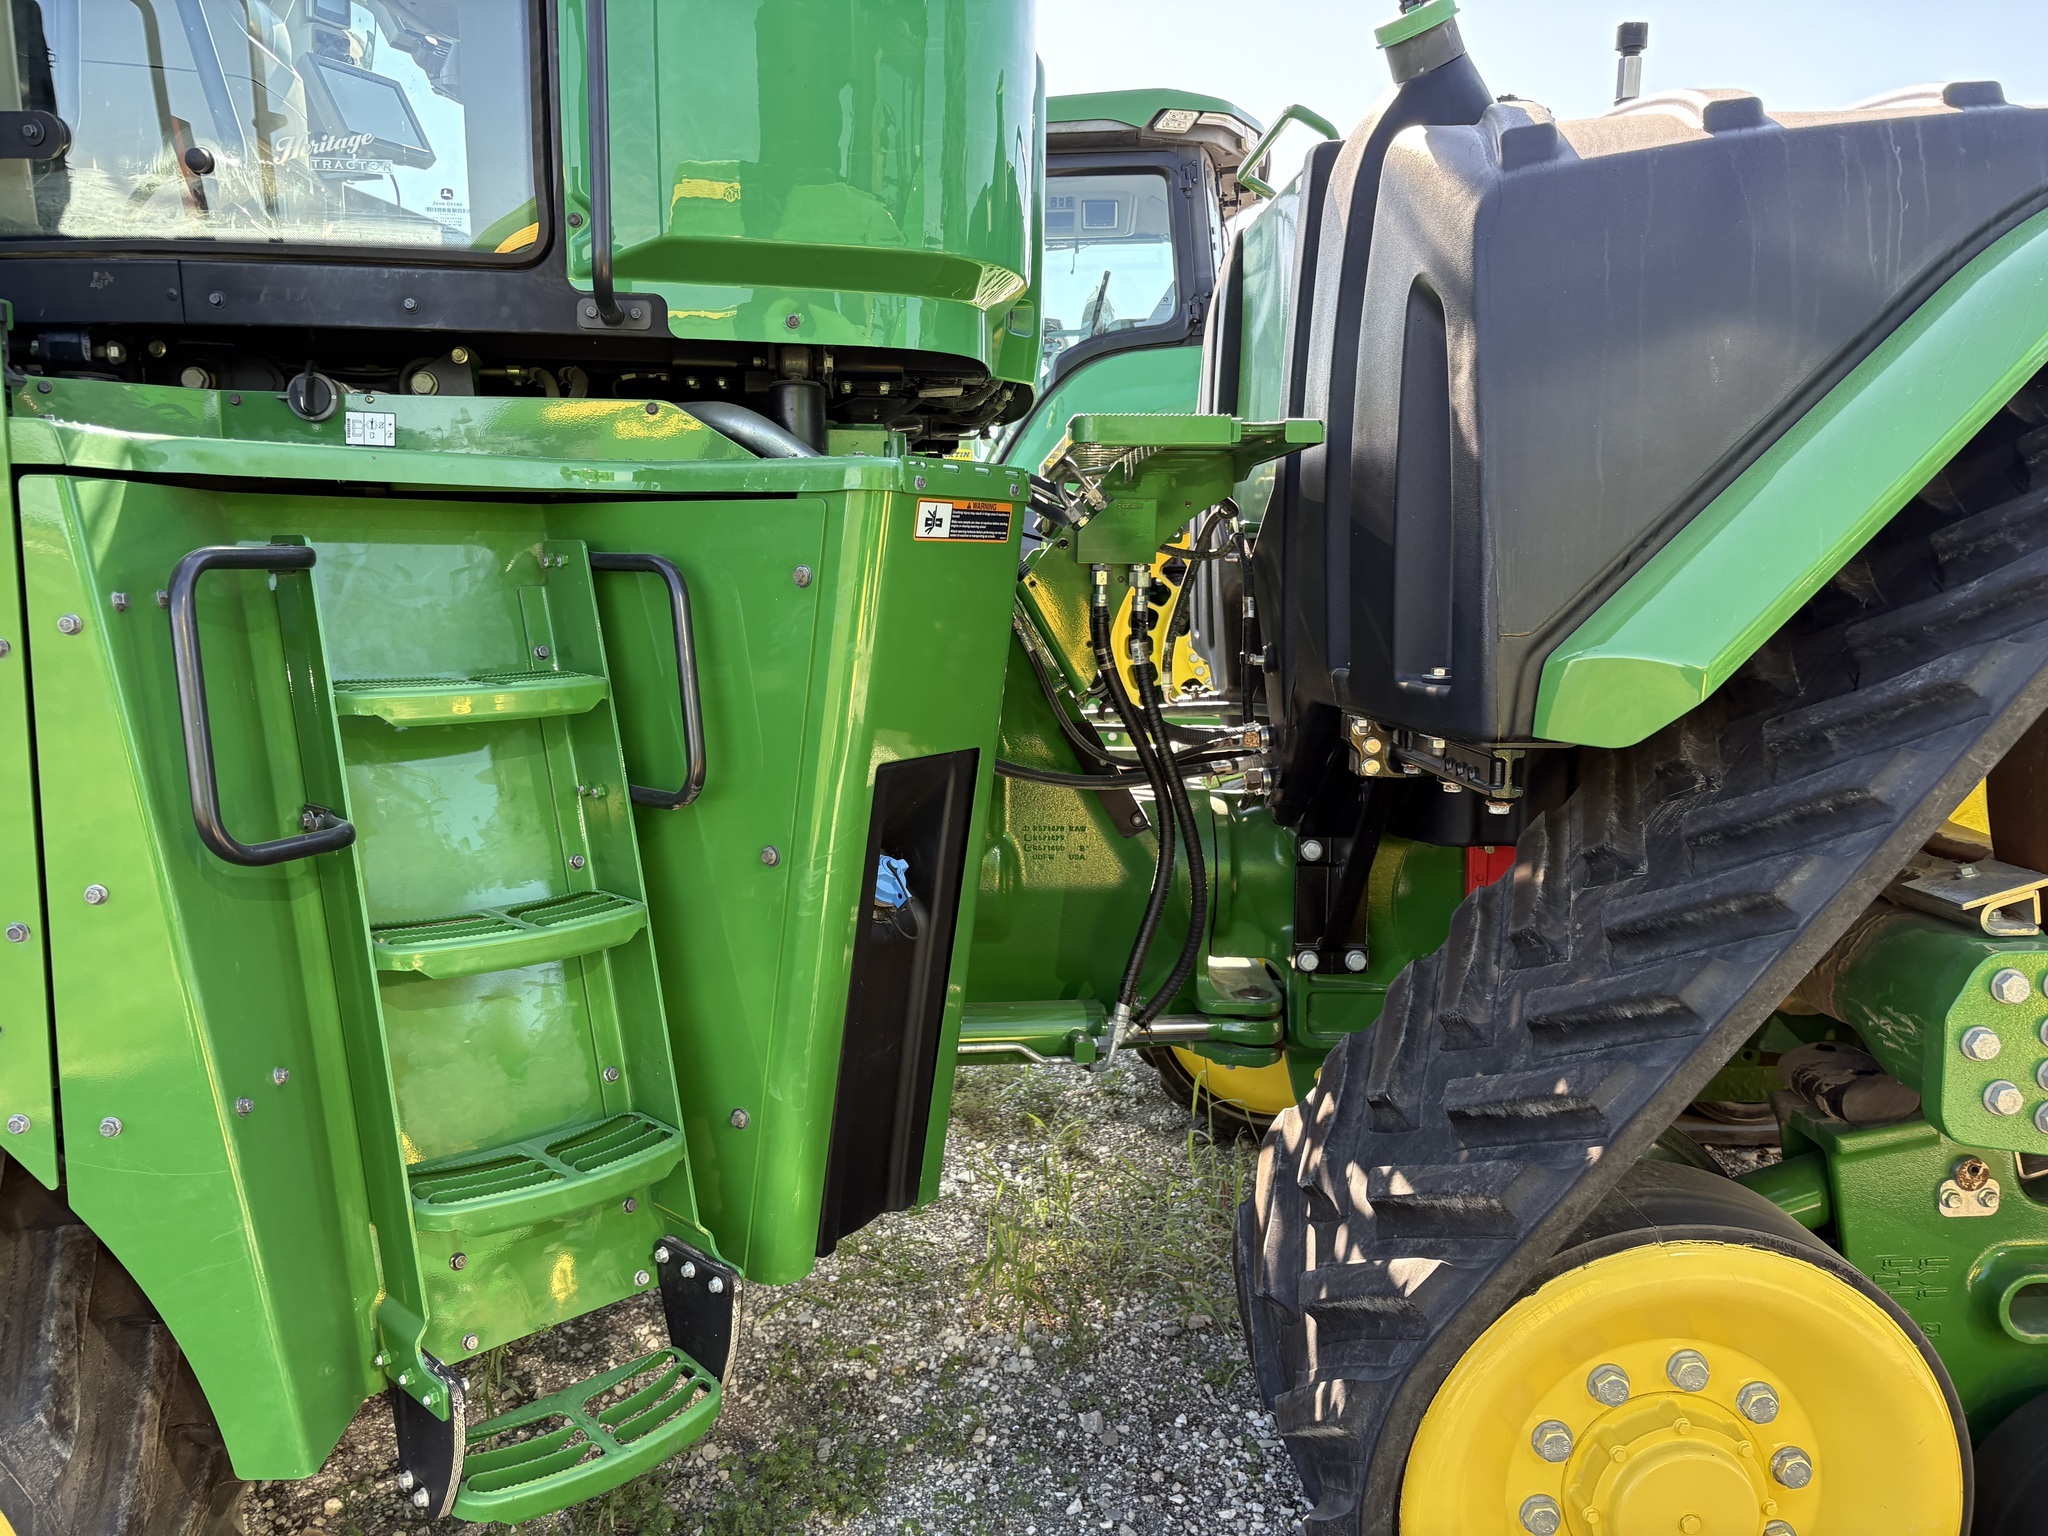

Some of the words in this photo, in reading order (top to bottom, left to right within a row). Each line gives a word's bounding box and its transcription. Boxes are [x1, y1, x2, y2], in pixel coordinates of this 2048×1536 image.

[273, 131, 375, 165] Heritage
[311, 158, 392, 172] TRACTOR
[972, 502, 998, 511] WARNING
